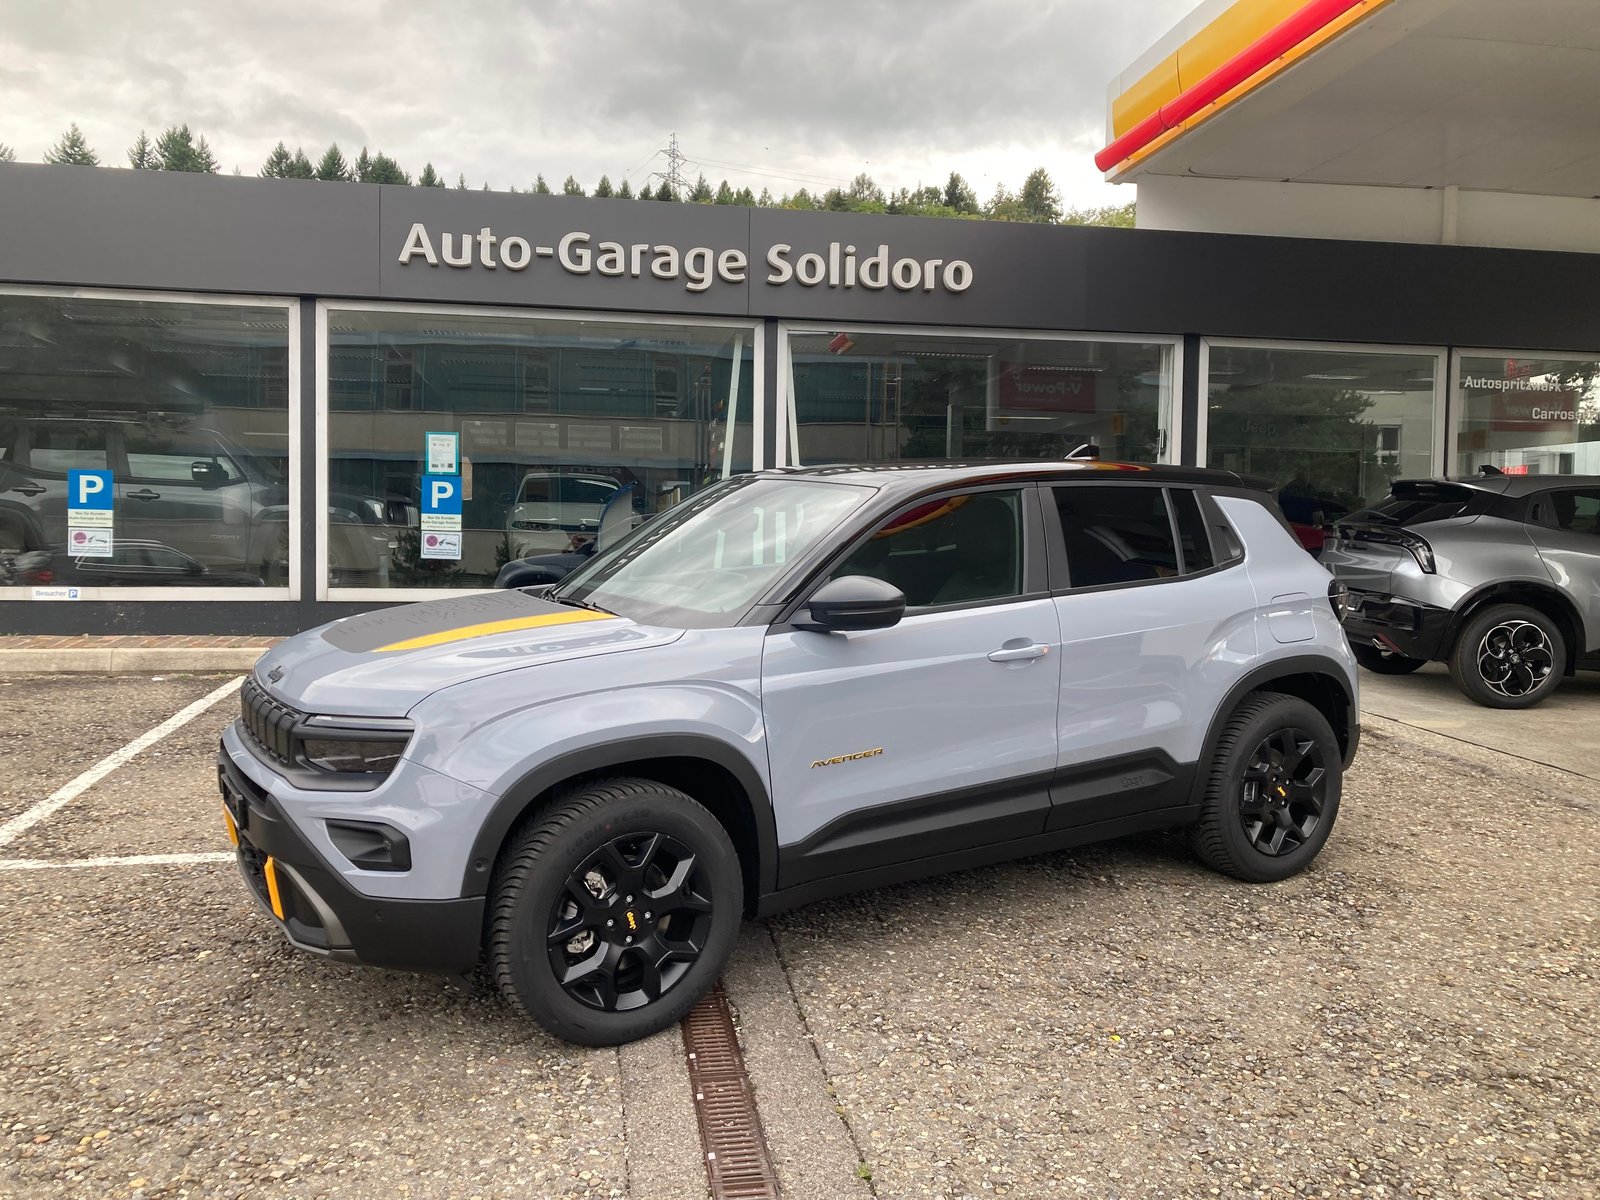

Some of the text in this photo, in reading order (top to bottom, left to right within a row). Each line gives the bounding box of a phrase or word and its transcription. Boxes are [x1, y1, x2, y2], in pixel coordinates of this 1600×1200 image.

[398, 223, 973, 292] Auto-Garage Solidoro
[79, 474, 104, 504] P
[431, 481, 454, 509] P
[810, 747, 883, 769] AVENGER
